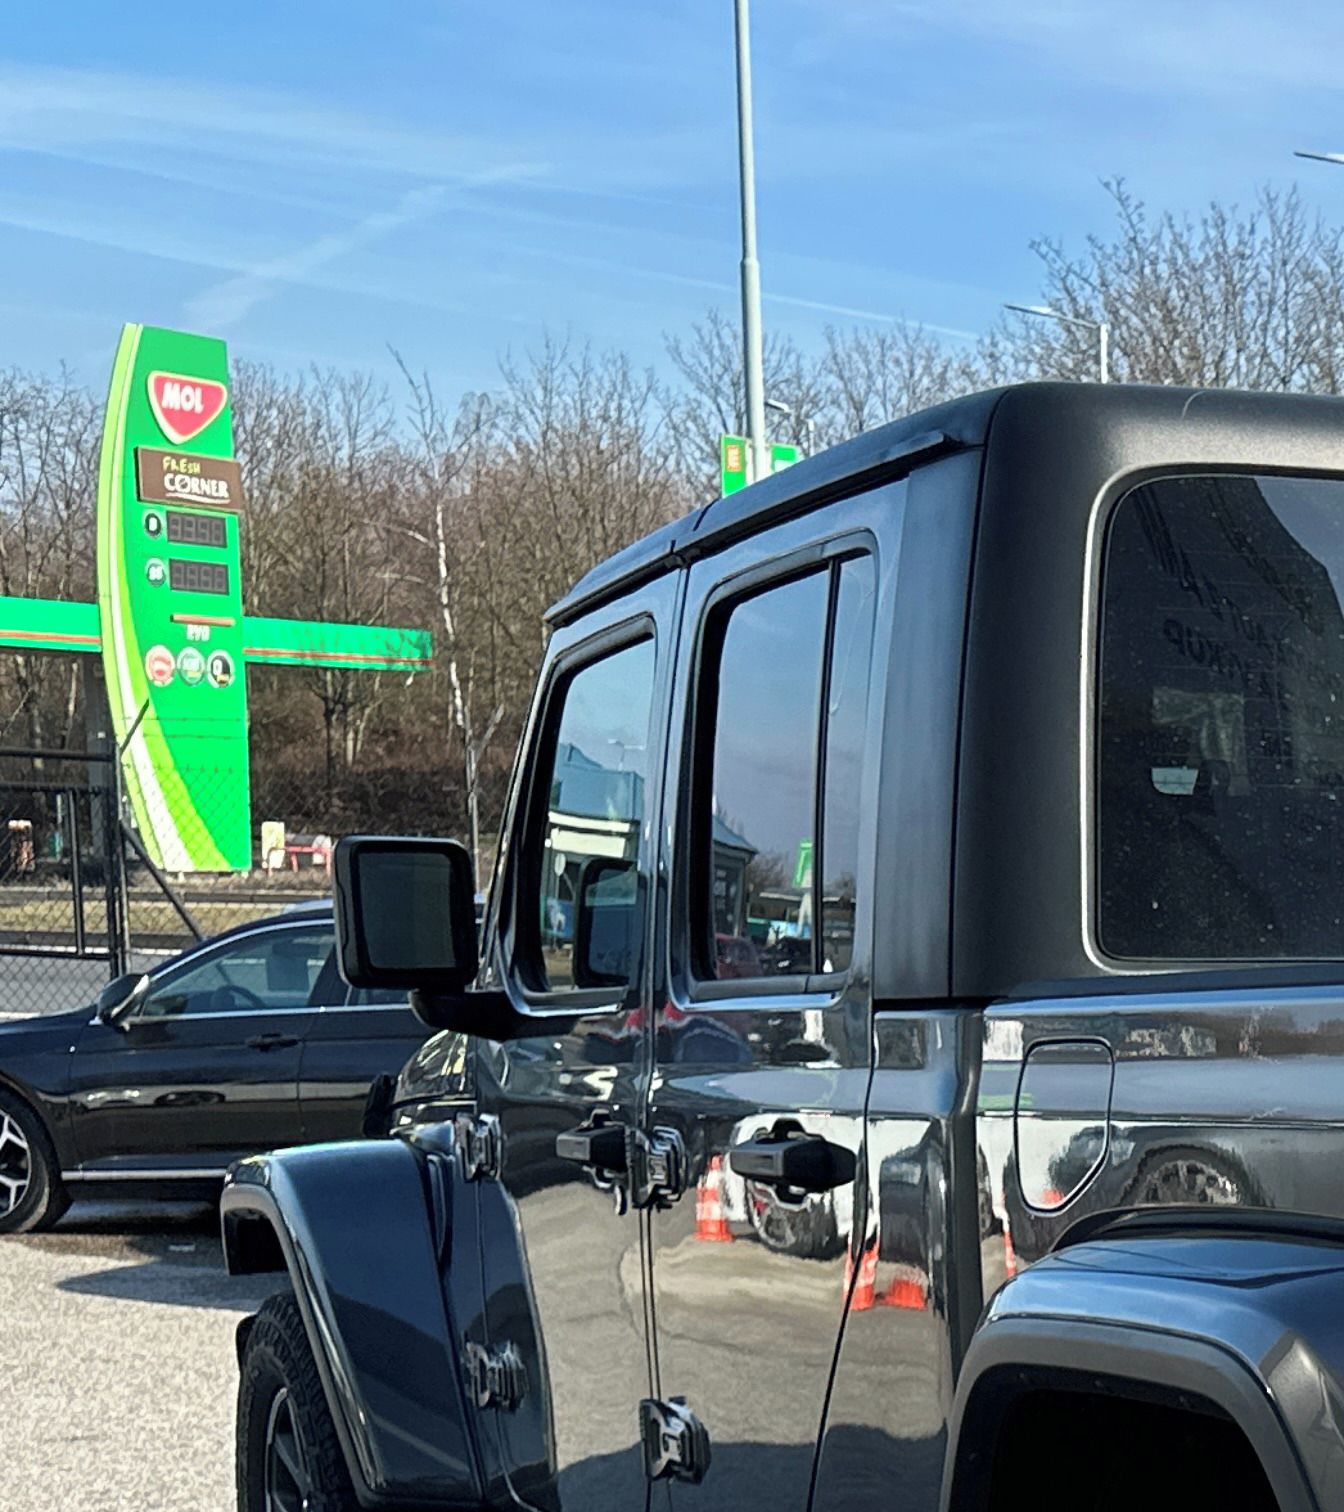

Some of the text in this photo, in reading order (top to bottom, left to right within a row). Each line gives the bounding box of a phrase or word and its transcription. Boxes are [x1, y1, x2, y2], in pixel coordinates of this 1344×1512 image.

[162, 381, 204, 414] MOL
[162, 456, 201, 475] FRESH
[163, 472, 230, 499] CORNER
